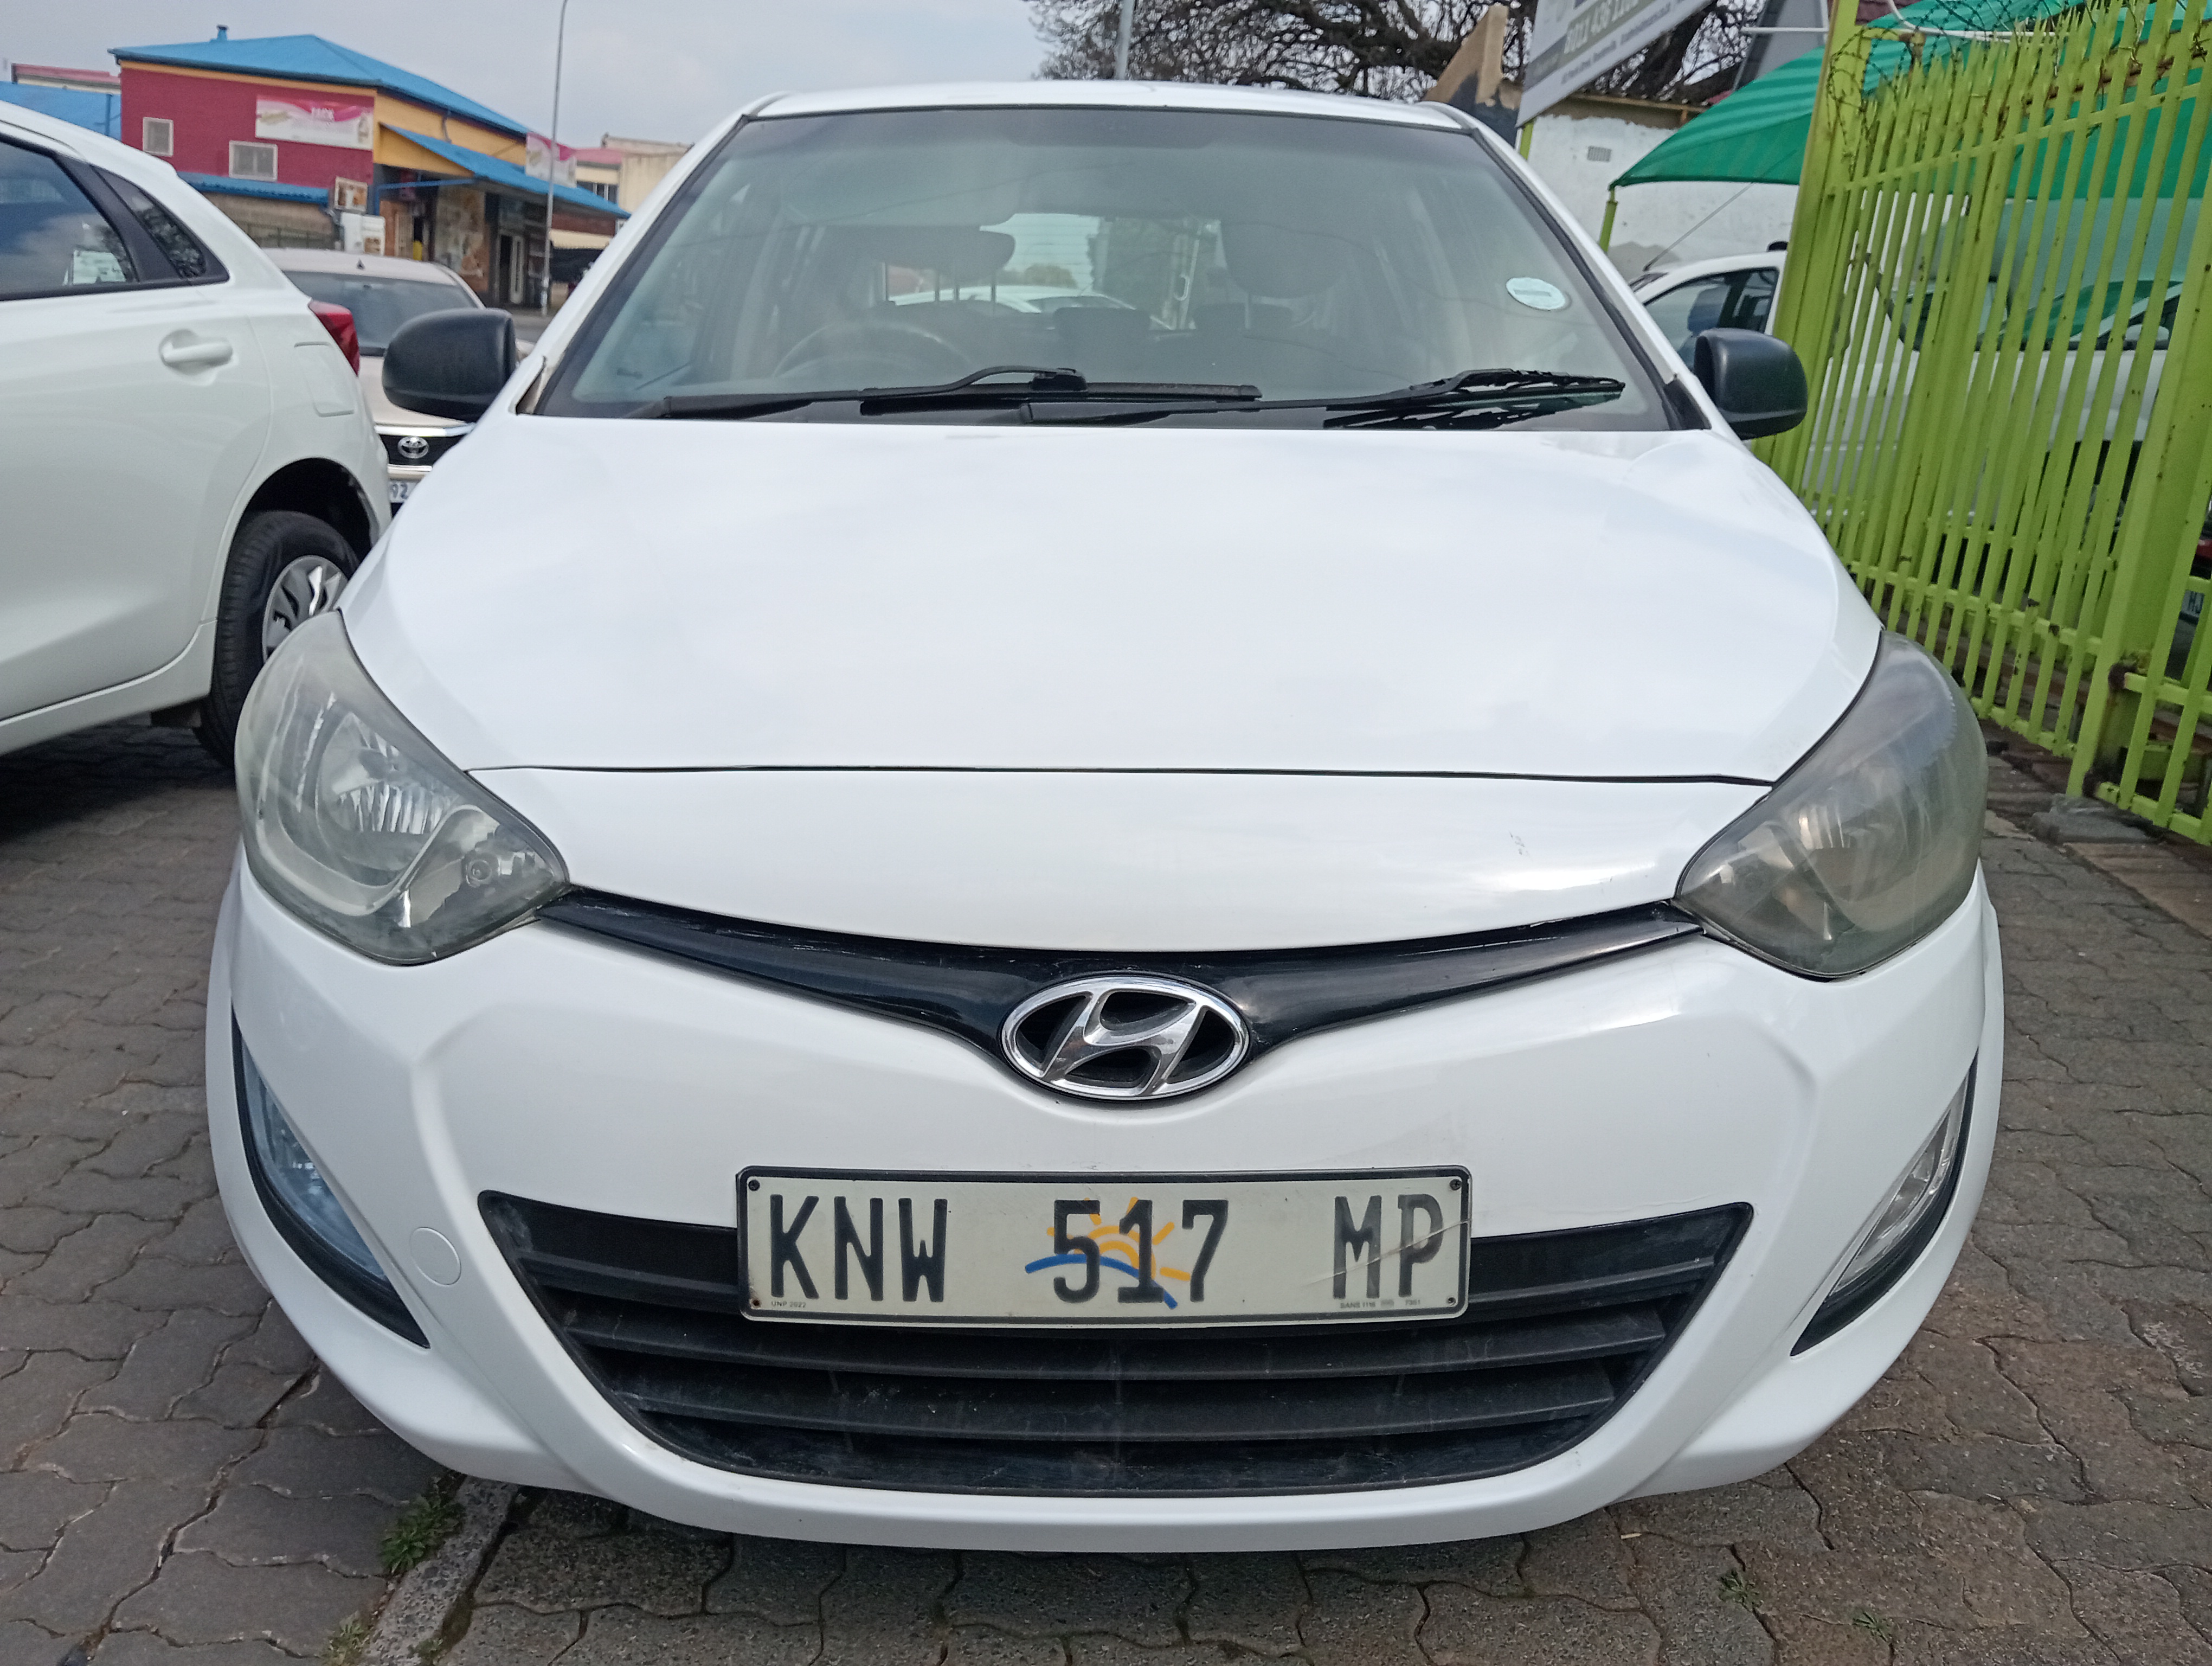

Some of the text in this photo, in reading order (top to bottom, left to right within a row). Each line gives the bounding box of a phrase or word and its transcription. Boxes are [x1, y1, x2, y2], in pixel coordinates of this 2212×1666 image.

[770, 1194, 1444, 1303] KNW 517 MP
